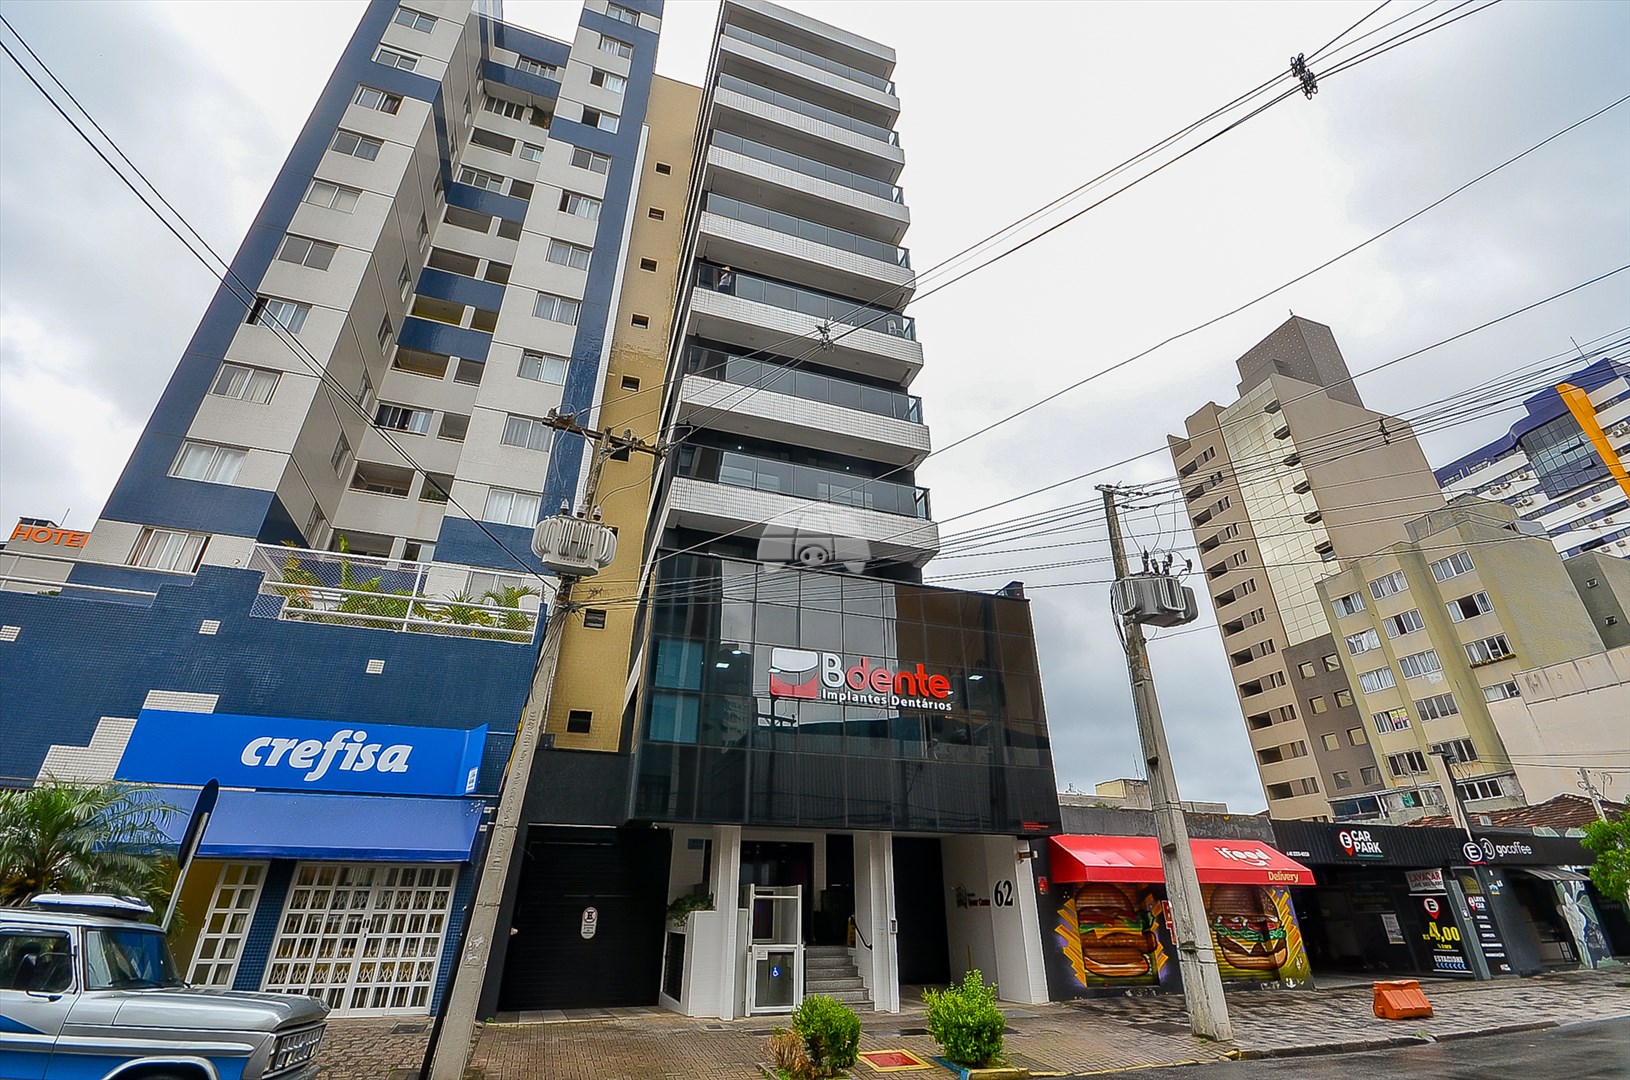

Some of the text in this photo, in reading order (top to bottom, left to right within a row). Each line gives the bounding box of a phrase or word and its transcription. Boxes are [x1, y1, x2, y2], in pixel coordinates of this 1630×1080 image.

[821, 652, 951, 698] Bdente
[822, 689, 952, 711] Implantes Dentários
[241, 729, 414, 782] crefisa
[1351, 830, 1372, 841] CAR
[1353, 841, 1382, 853] PARK
[1495, 842, 1533, 857] gocoffee
[1267, 870, 1299, 883] Delivery
[994, 880, 1013, 907] 62
[1429, 922, 1460, 942] 4,00
